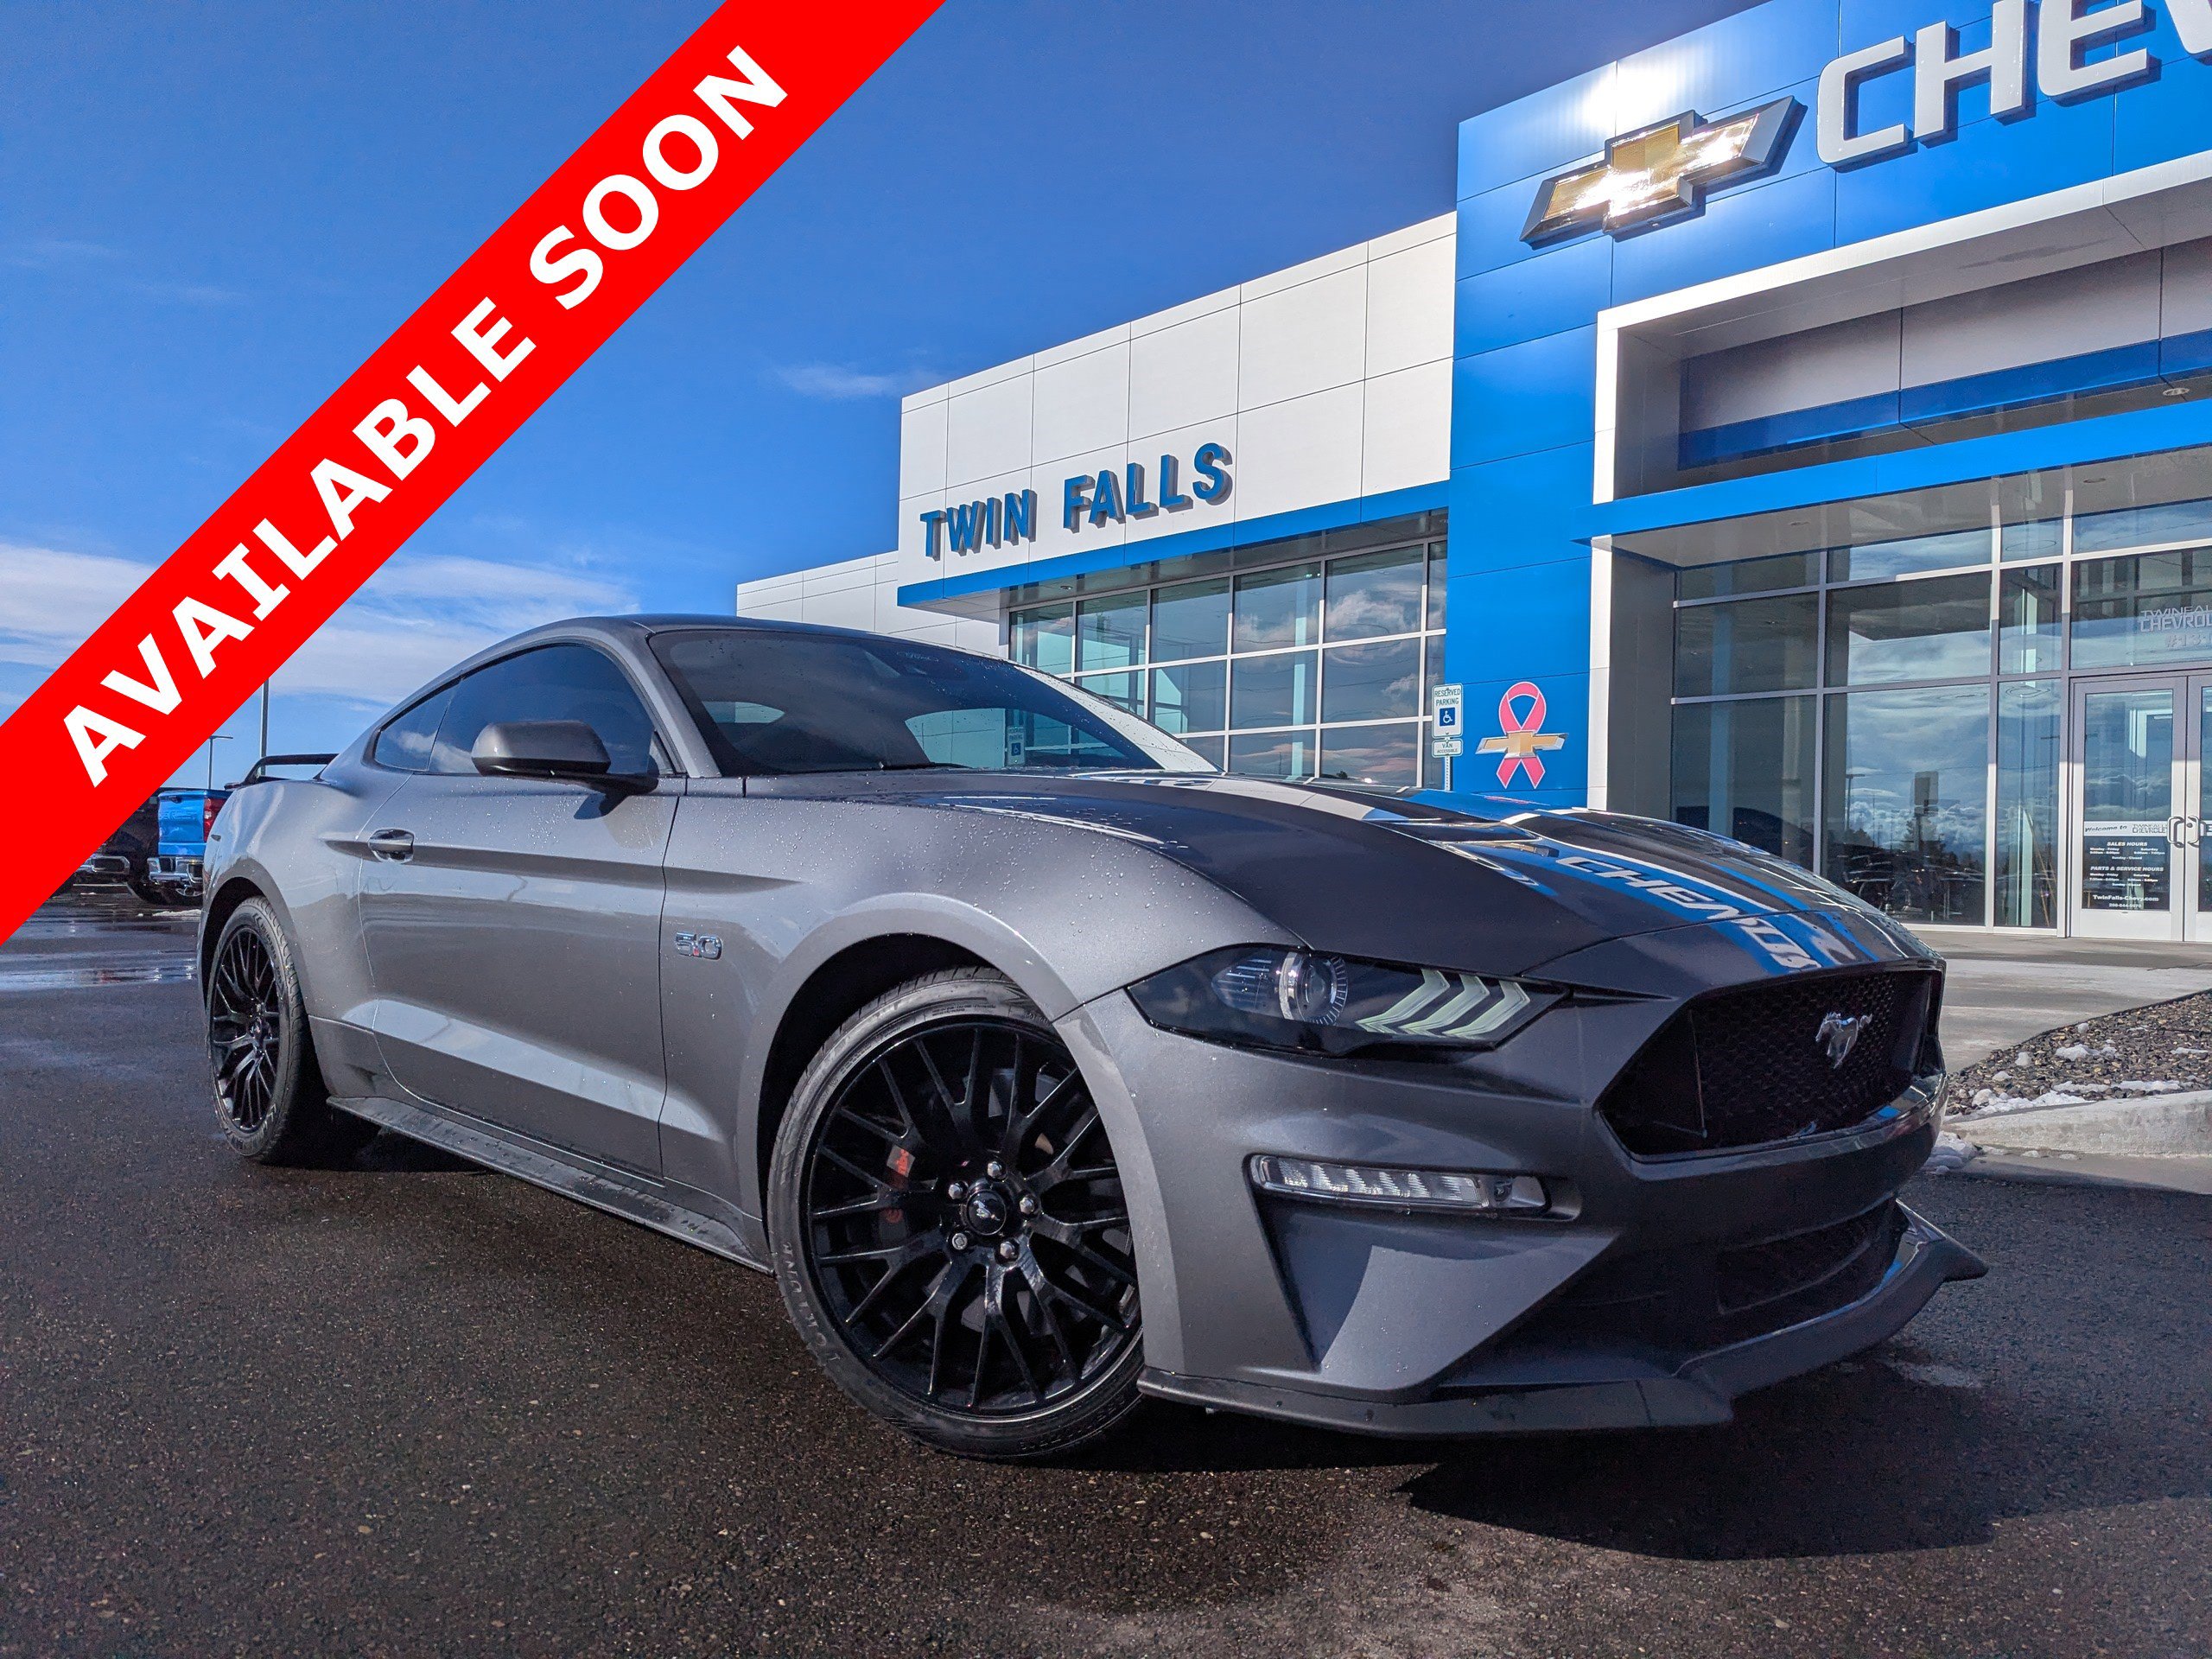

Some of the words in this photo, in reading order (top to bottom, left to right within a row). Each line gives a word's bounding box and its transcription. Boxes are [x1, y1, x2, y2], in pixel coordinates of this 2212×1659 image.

[920, 489, 1038, 561] TWIN
[1063, 442, 1233, 533] FALLS
[1434, 688, 1461, 697] RESERVED
[1435, 697, 1459, 707] PARKING
[675, 932, 722, 960] 5.0
